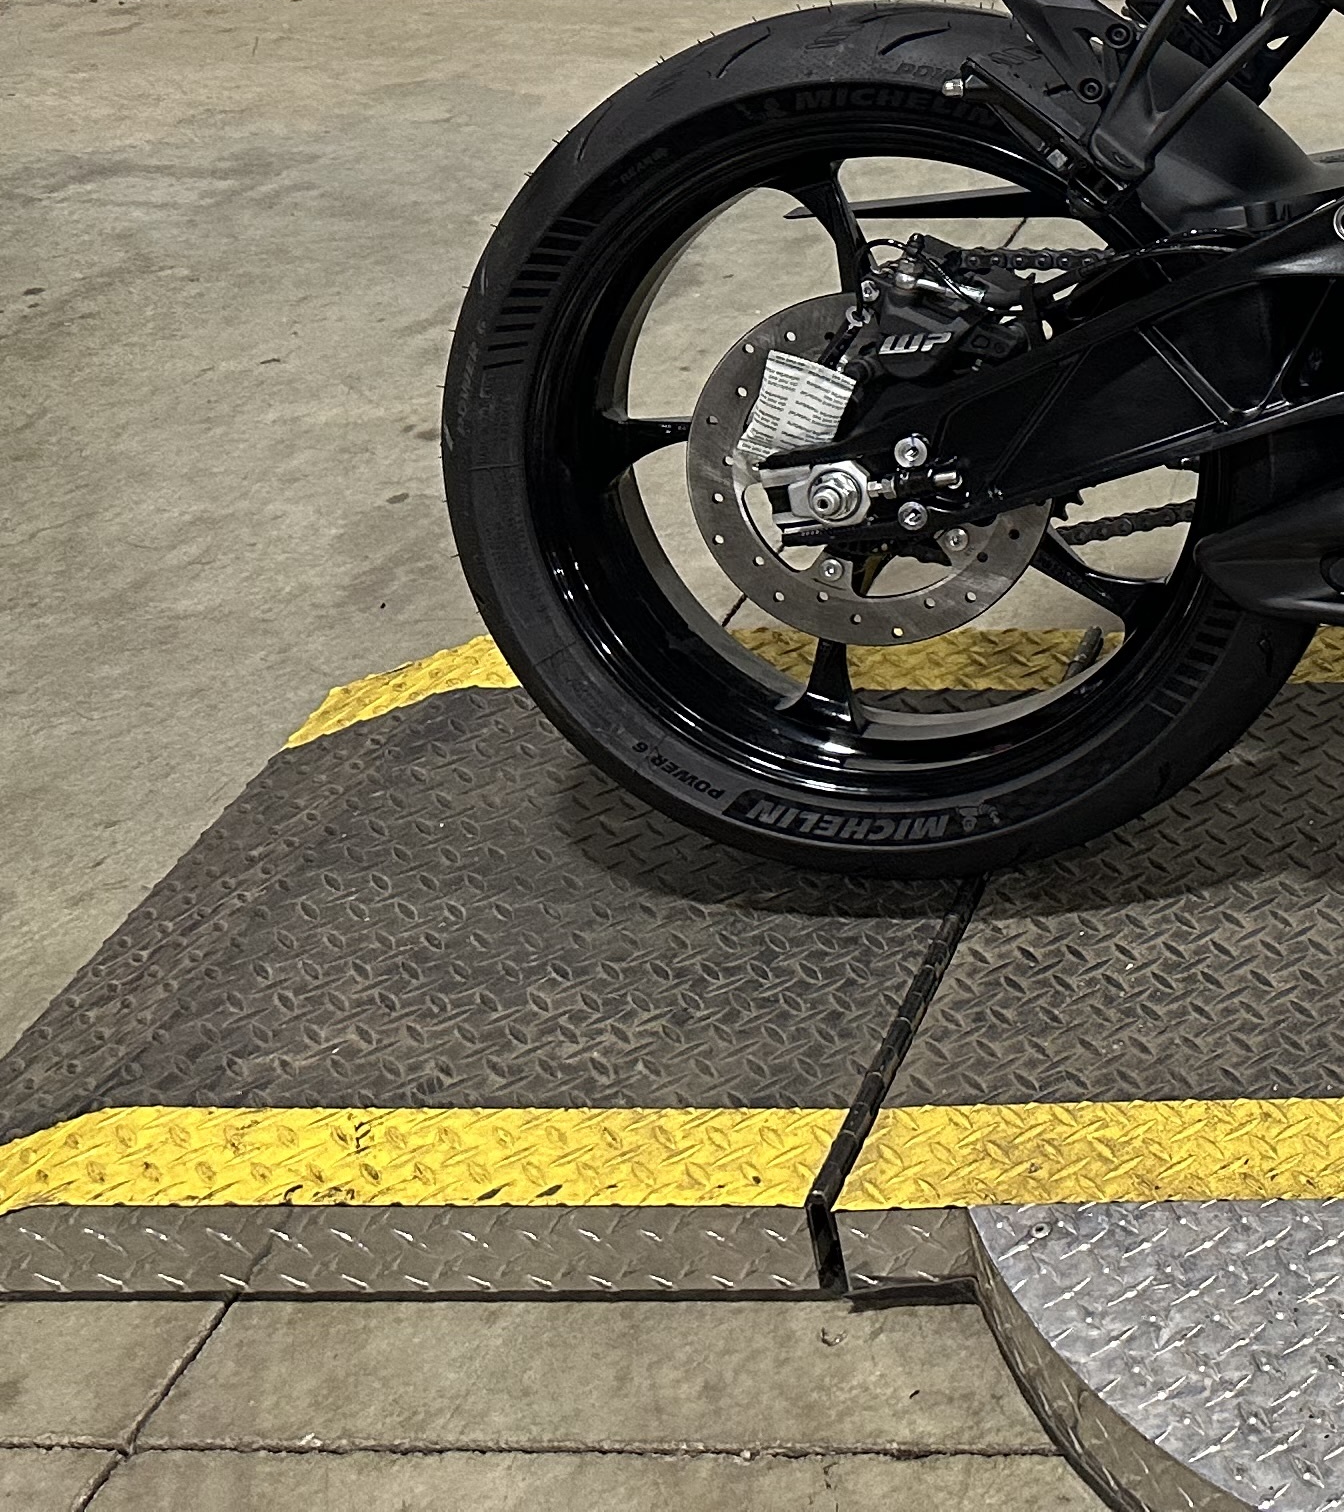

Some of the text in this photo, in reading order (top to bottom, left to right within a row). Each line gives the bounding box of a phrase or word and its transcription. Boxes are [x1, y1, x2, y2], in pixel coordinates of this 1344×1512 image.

[795, 88, 998, 126] MICHELIN
[879, 331, 952, 355] WP
[631, 740, 726, 800] POWER 6
[745, 798, 950, 842] MICHELIN
